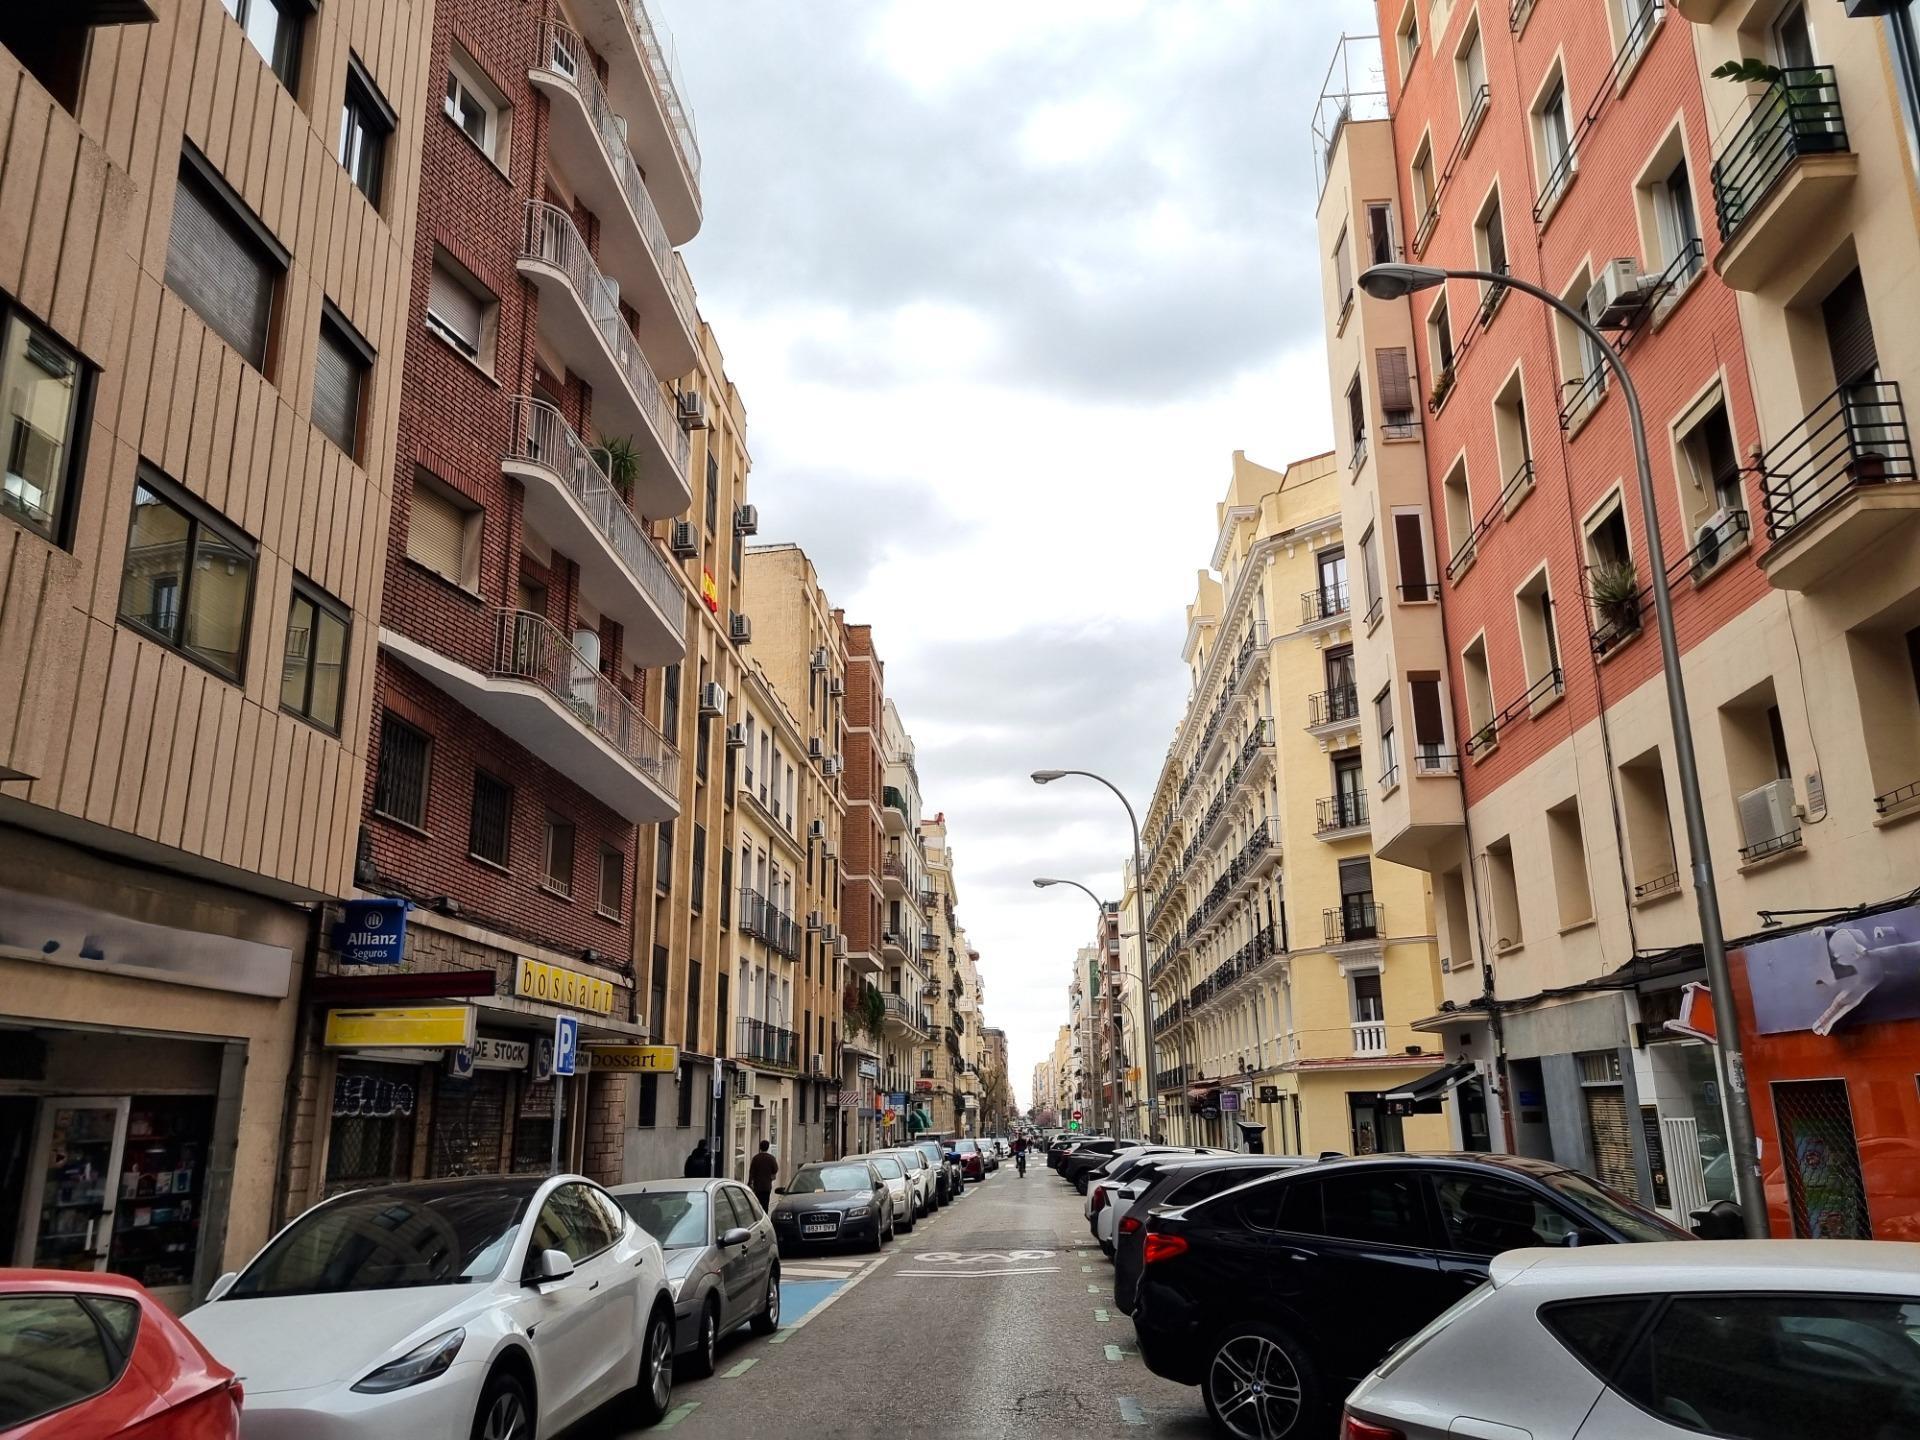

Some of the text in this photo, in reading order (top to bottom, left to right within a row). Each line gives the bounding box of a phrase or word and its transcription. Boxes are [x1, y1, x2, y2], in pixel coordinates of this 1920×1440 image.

[346, 932, 397, 945] Allianz
[353, 949, 387, 960] Seguros
[523, 962, 609, 1011] bossart
[494, 1043, 525, 1061] STOCK
[558, 1023, 572, 1068] P
[591, 1052, 656, 1068] bossart
